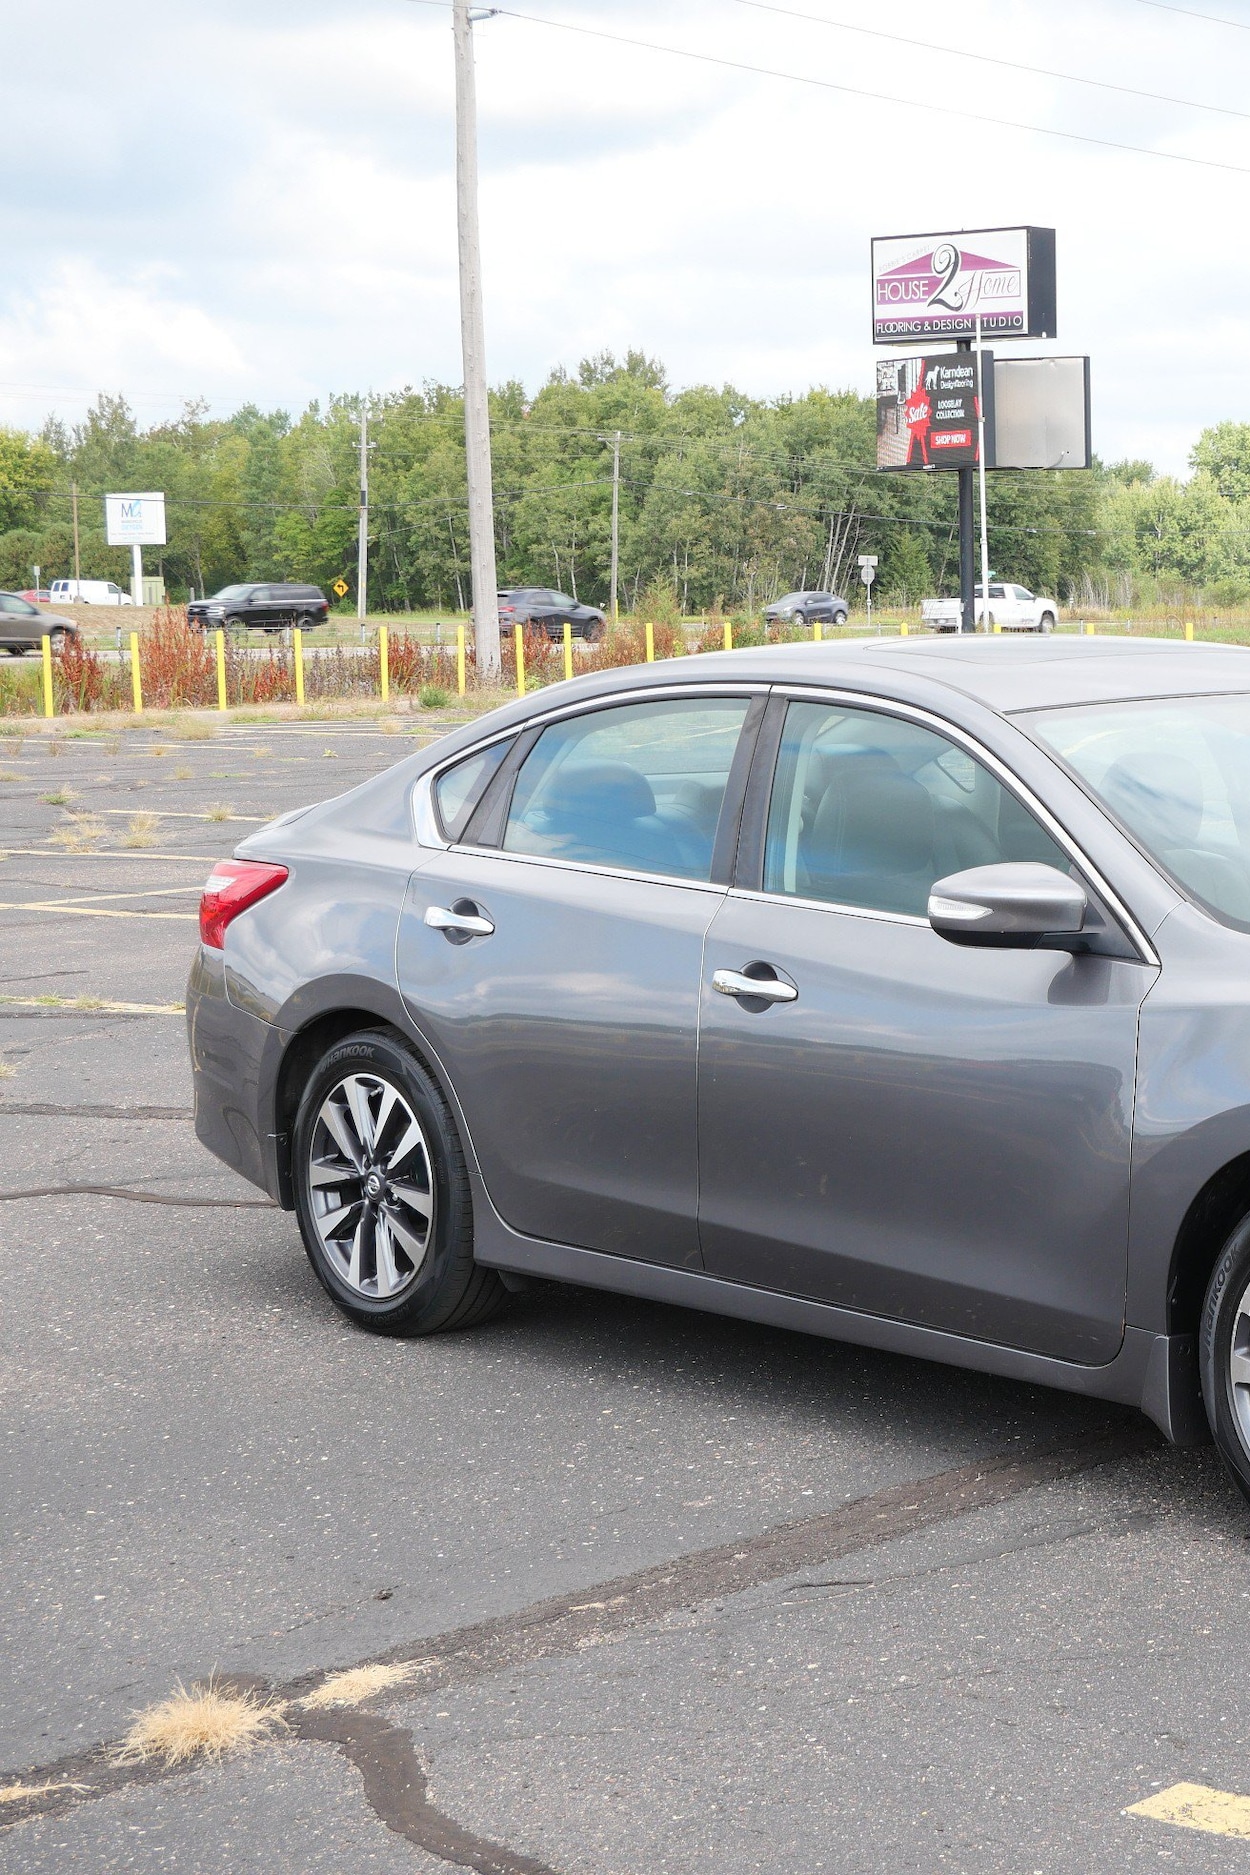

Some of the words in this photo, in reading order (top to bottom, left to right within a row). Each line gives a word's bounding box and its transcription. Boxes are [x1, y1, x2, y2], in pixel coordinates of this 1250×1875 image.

[877, 280, 929, 302] HOUSE
[927, 243, 964, 312] 2
[958, 270, 1018, 311] Home
[876, 320, 922, 334] FLOORING
[923, 321, 932, 331] &
[933, 318, 972, 331] DESIGN
[975, 315, 1022, 328] TUDIO
[940, 365, 974, 379] Karndean
[908, 402, 928, 424] Sale
[936, 409, 965, 420] COLLECTION
[935, 435, 950, 446] SHOP
[951, 434, 966, 444] NOW
